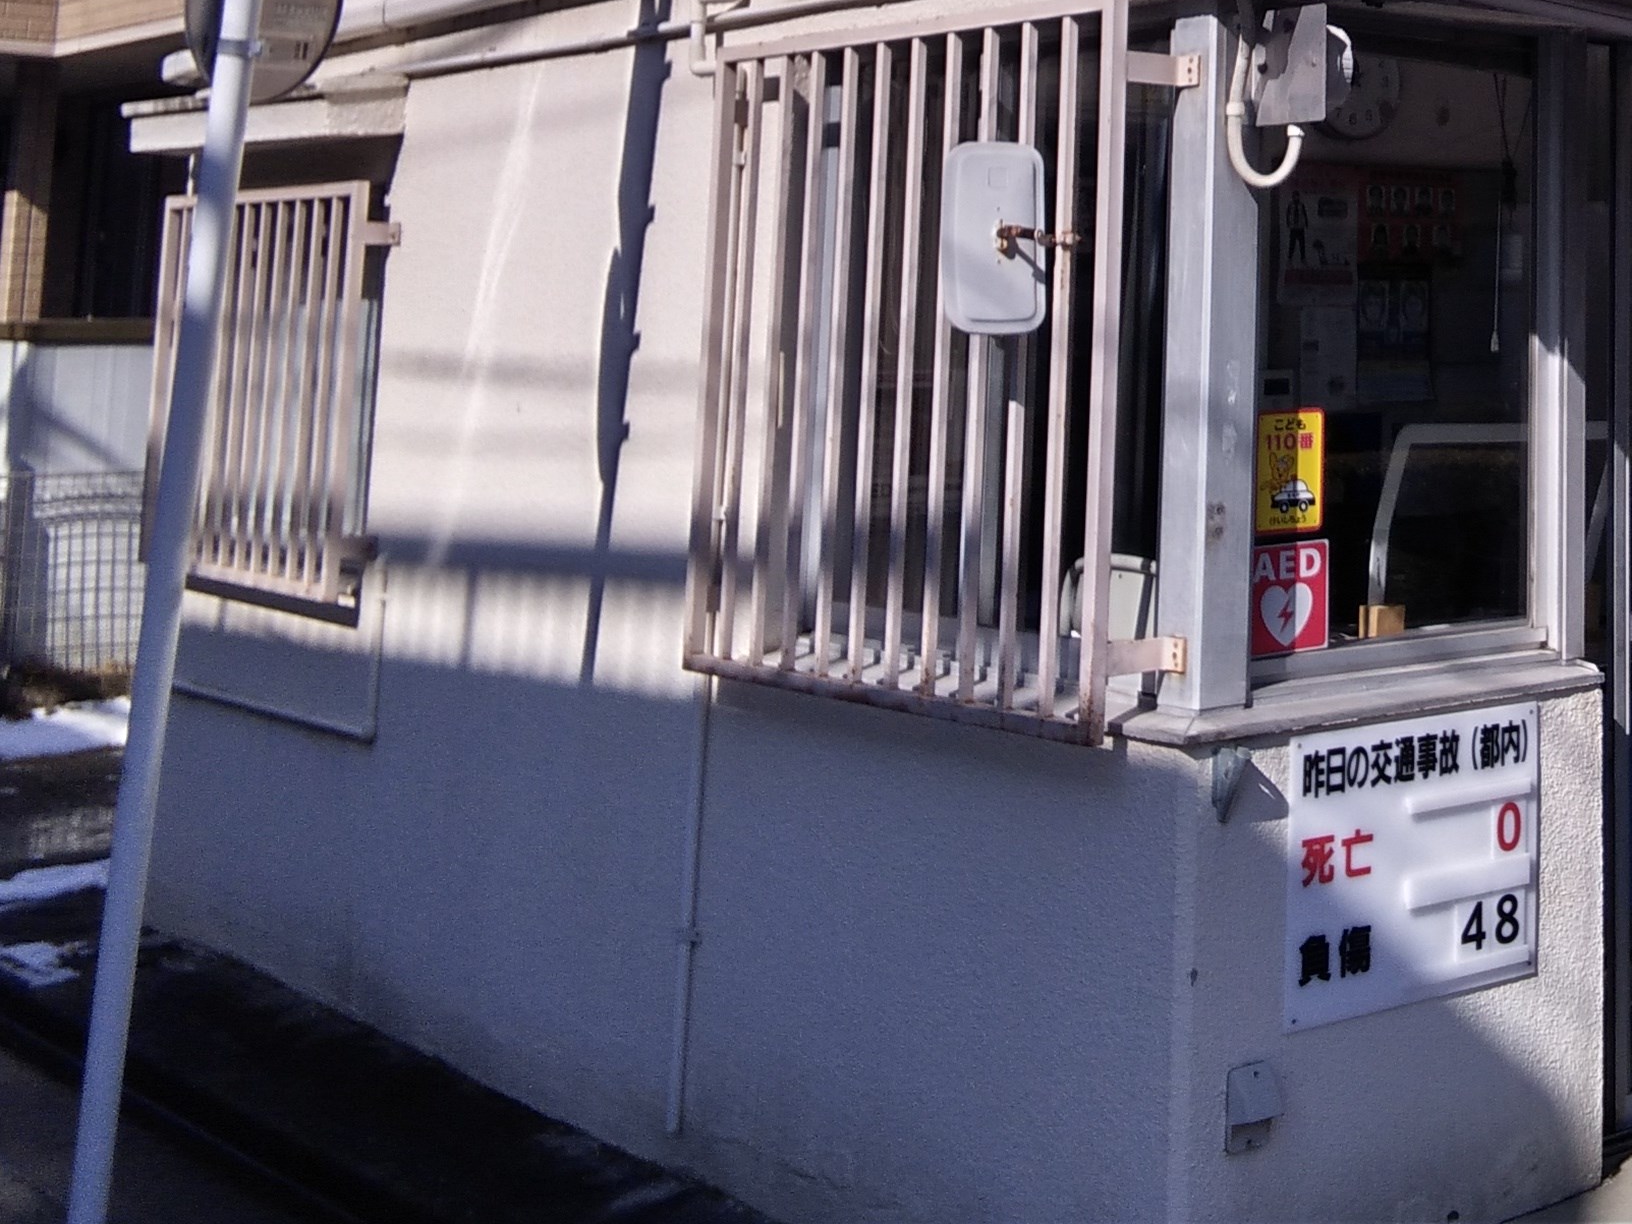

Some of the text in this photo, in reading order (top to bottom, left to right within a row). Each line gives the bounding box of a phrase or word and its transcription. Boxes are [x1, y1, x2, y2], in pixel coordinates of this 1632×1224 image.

[1266, 432, 1313, 451] 110番
[1273, 417, 1307, 431] こども
[1253, 547, 1322, 583] AED
[1496, 801, 1522, 852] 0
[1301, 829, 1374, 888] 死亡
[1460, 893, 1520, 951] 48
[1298, 925, 1372, 987] 負傷
